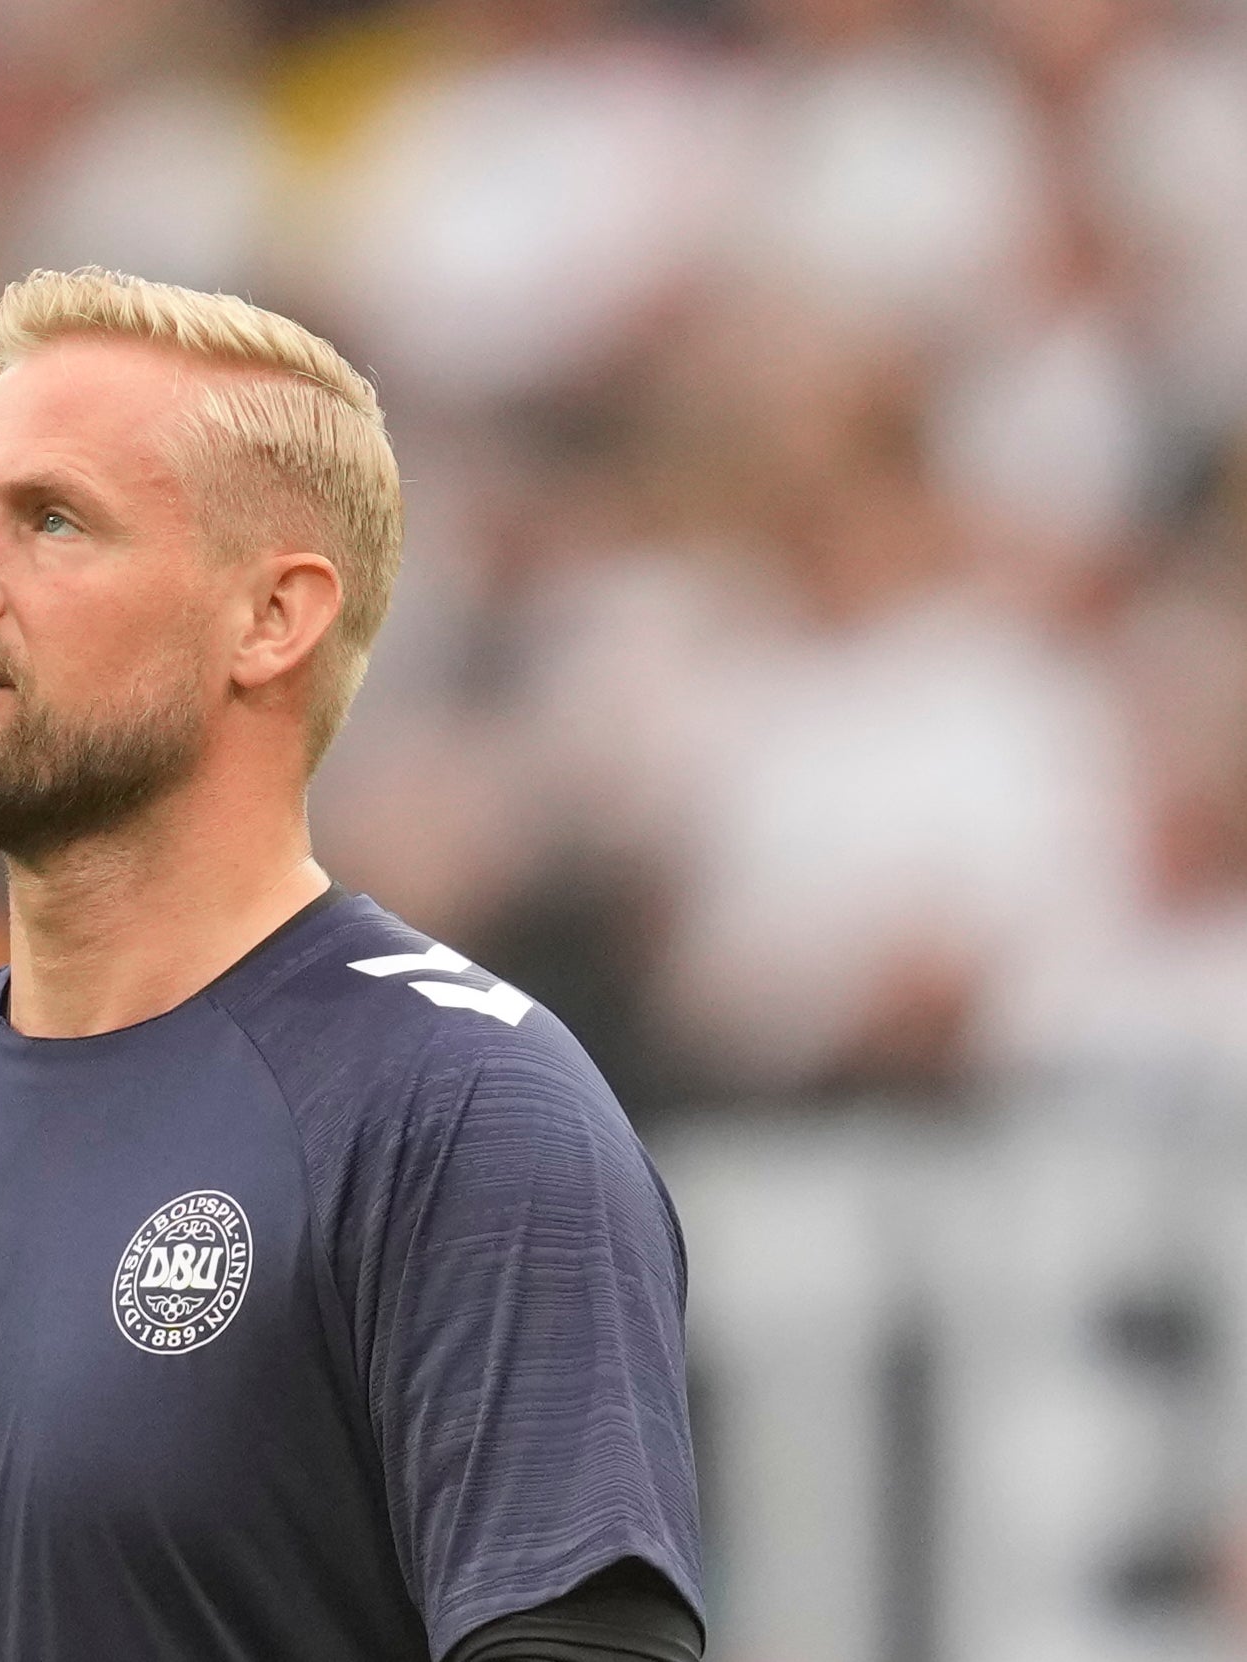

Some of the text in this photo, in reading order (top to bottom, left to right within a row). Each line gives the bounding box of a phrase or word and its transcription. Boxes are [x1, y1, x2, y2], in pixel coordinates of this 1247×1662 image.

[118, 1235, 151, 1329] DANSK
[139, 1242, 225, 1290] DBU
[139, 1323, 197, 1348] 1889
